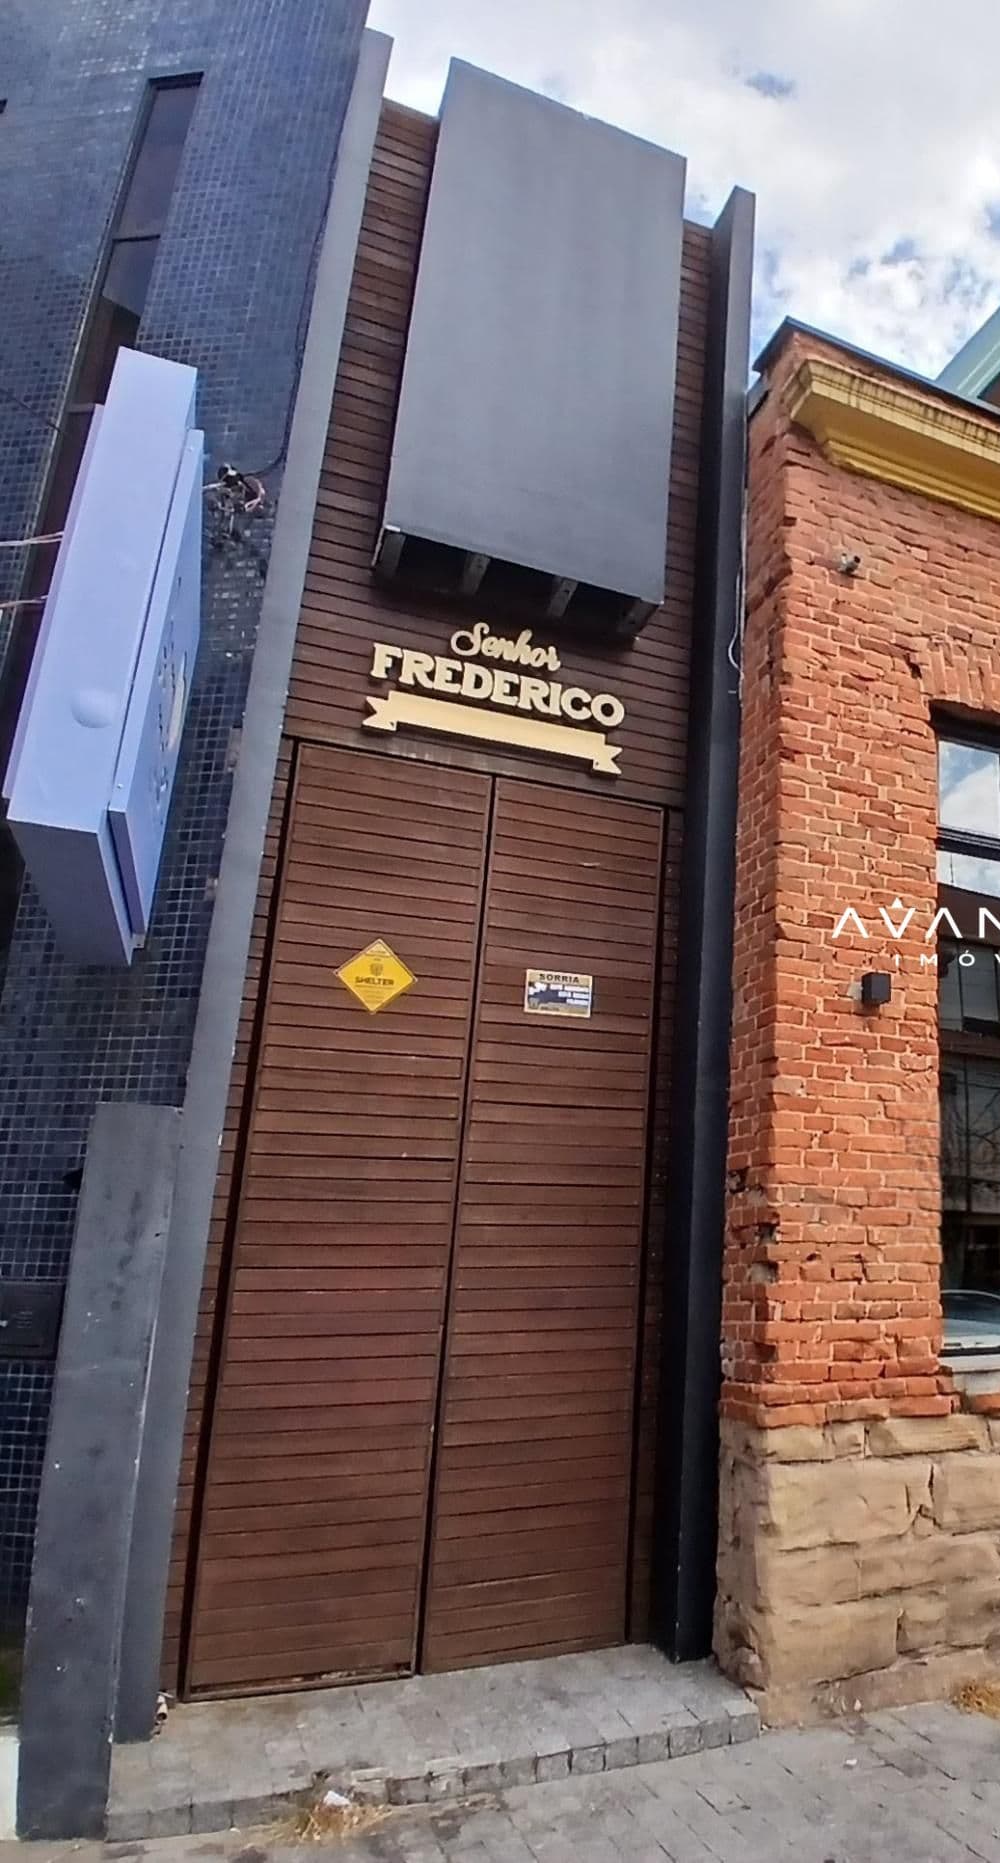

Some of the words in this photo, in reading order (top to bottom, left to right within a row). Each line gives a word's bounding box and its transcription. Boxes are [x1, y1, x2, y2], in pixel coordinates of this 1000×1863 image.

[450, 622, 561, 671] Senhor
[369, 642, 625, 726] FREDERICO
[355, 976, 395, 986] SHELTER
[539, 973, 580, 983] SORRIA
